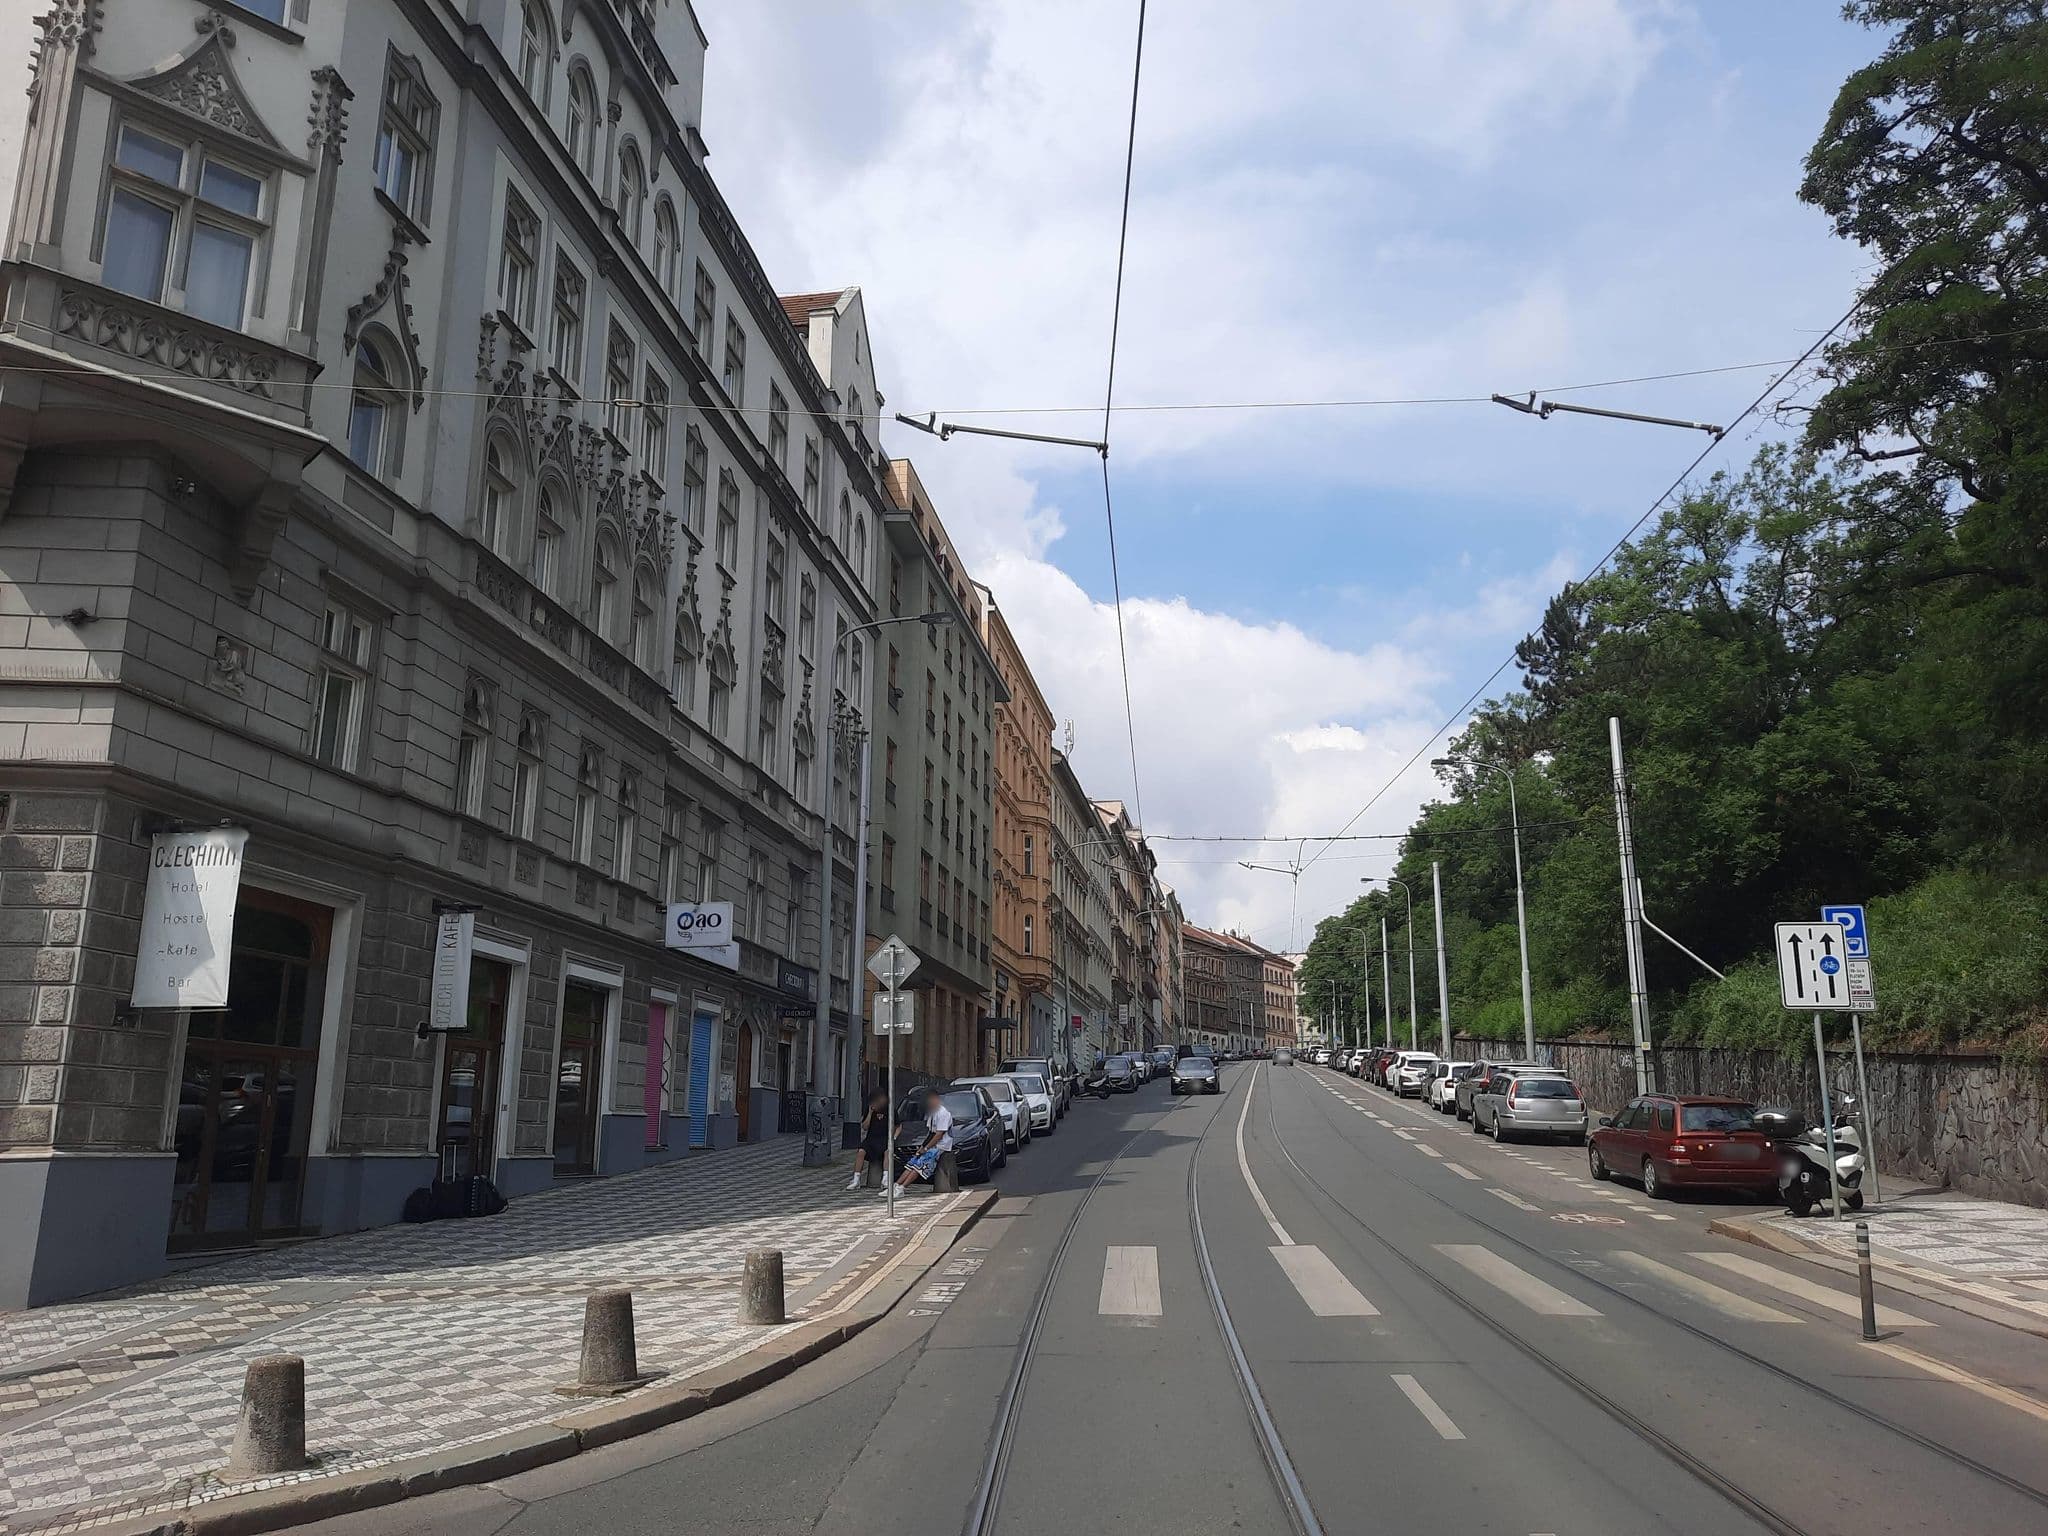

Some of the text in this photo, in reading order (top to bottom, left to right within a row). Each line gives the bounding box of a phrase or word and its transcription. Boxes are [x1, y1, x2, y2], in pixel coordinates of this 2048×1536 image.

[171, 881, 209, 893] Hotel
[163, 913, 209, 924] Hostel
[1832, 912, 1856, 931] P
[443, 916, 459, 948] KAFE
[168, 977, 191, 988] Bar
